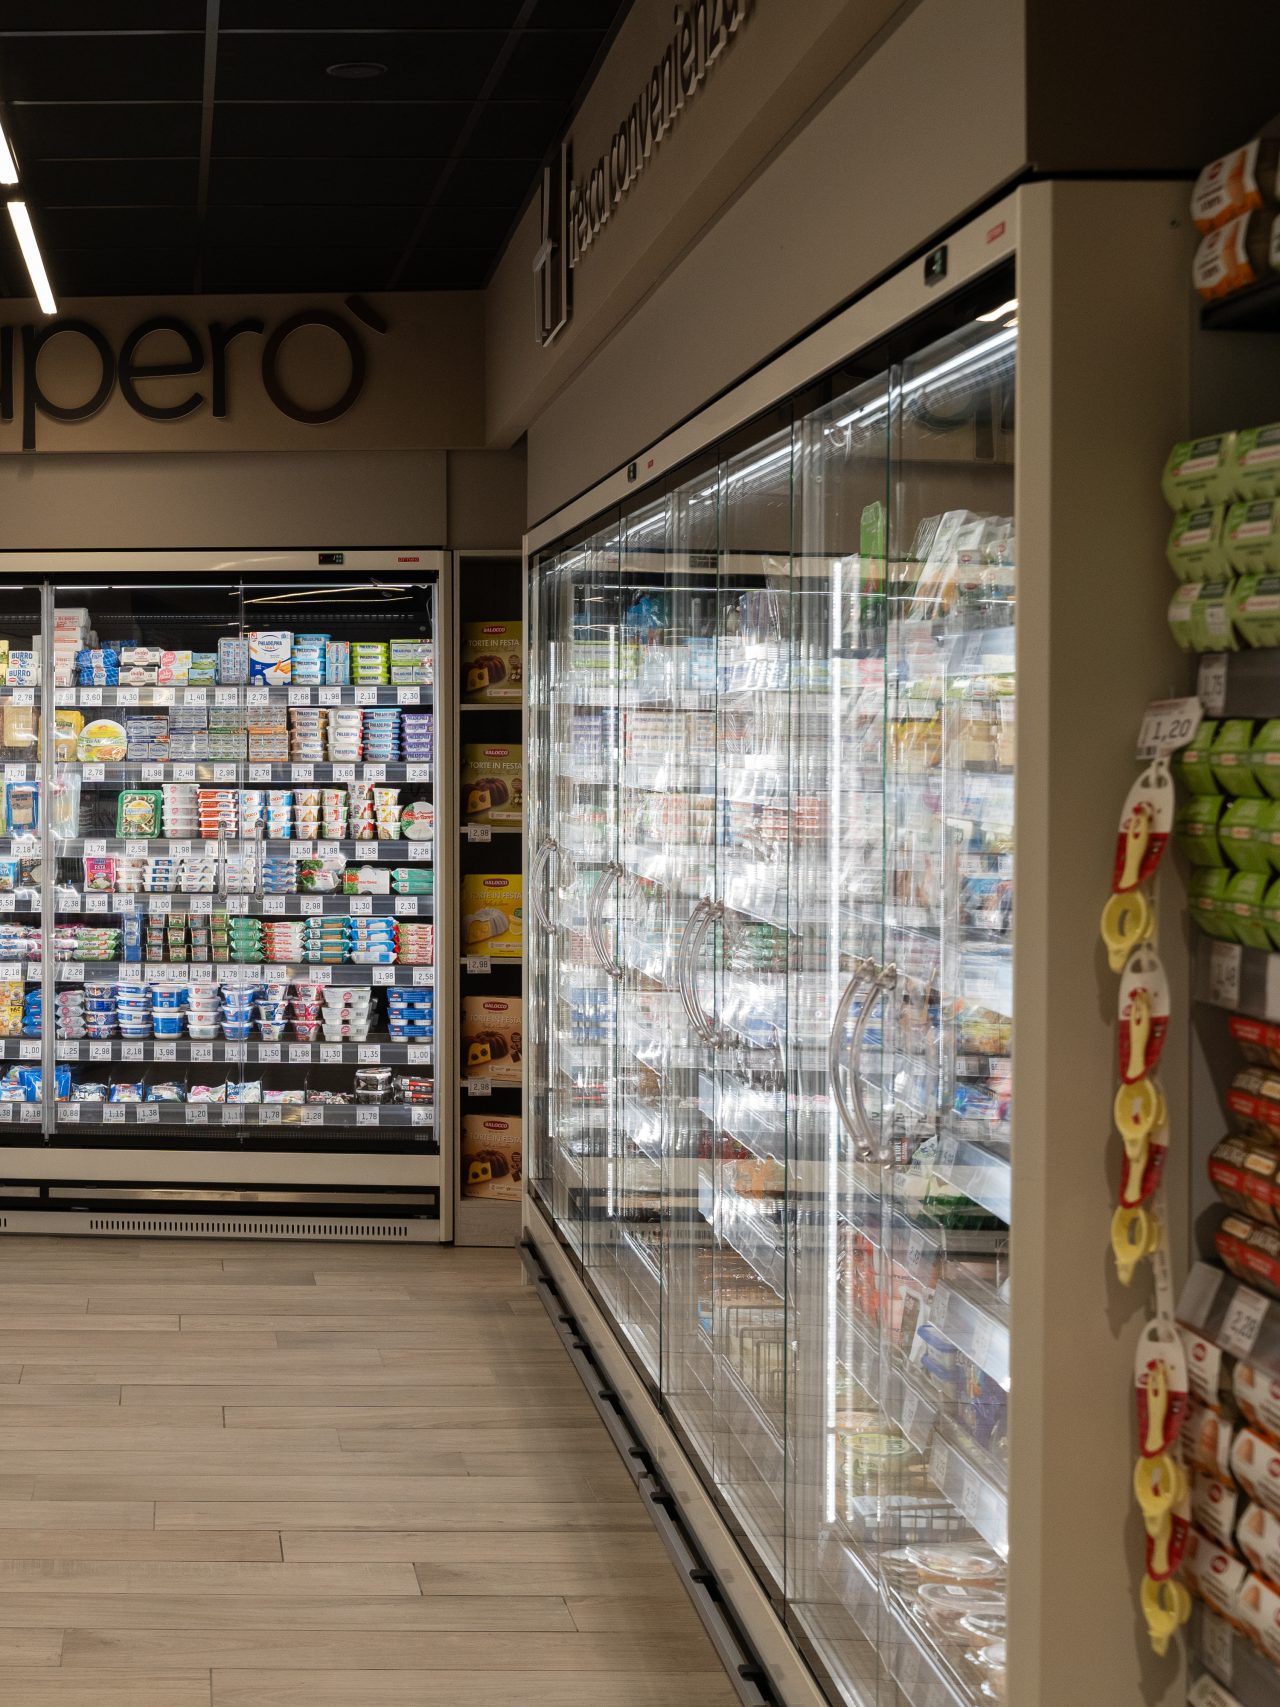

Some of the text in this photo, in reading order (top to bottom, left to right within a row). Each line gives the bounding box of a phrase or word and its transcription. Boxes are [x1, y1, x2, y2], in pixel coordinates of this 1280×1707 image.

[17, 694, 32, 702] 2,78
[190, 694, 204, 702] 1,40
[252, 694, 267, 702] 2,78
[1152, 719, 1192, 742] 1,20
[147, 770, 162, 778] 1,98
[178, 770, 194, 778] 2,48
[219, 770, 234, 778] 2,98
[254, 770, 270, 778] 2,78
[296, 770, 312, 778] 1,78
[368, 770, 384, 778] 1,98
[412, 770, 427, 778] 2,28
[473, 830, 489, 838] 2,98
[174, 846, 190, 854] 1,98
[414, 848, 428, 856] 2,28
[472, 960, 488, 970] 2,98
[4, 968, 19, 976] 2,18
[172, 970, 186, 978] 1,88
[378, 972, 393, 980] 1,98
[418, 972, 433, 980] 2,58
[190, 1110, 206, 1118] 1,20
[417, 1112, 432, 1120] 2,30
